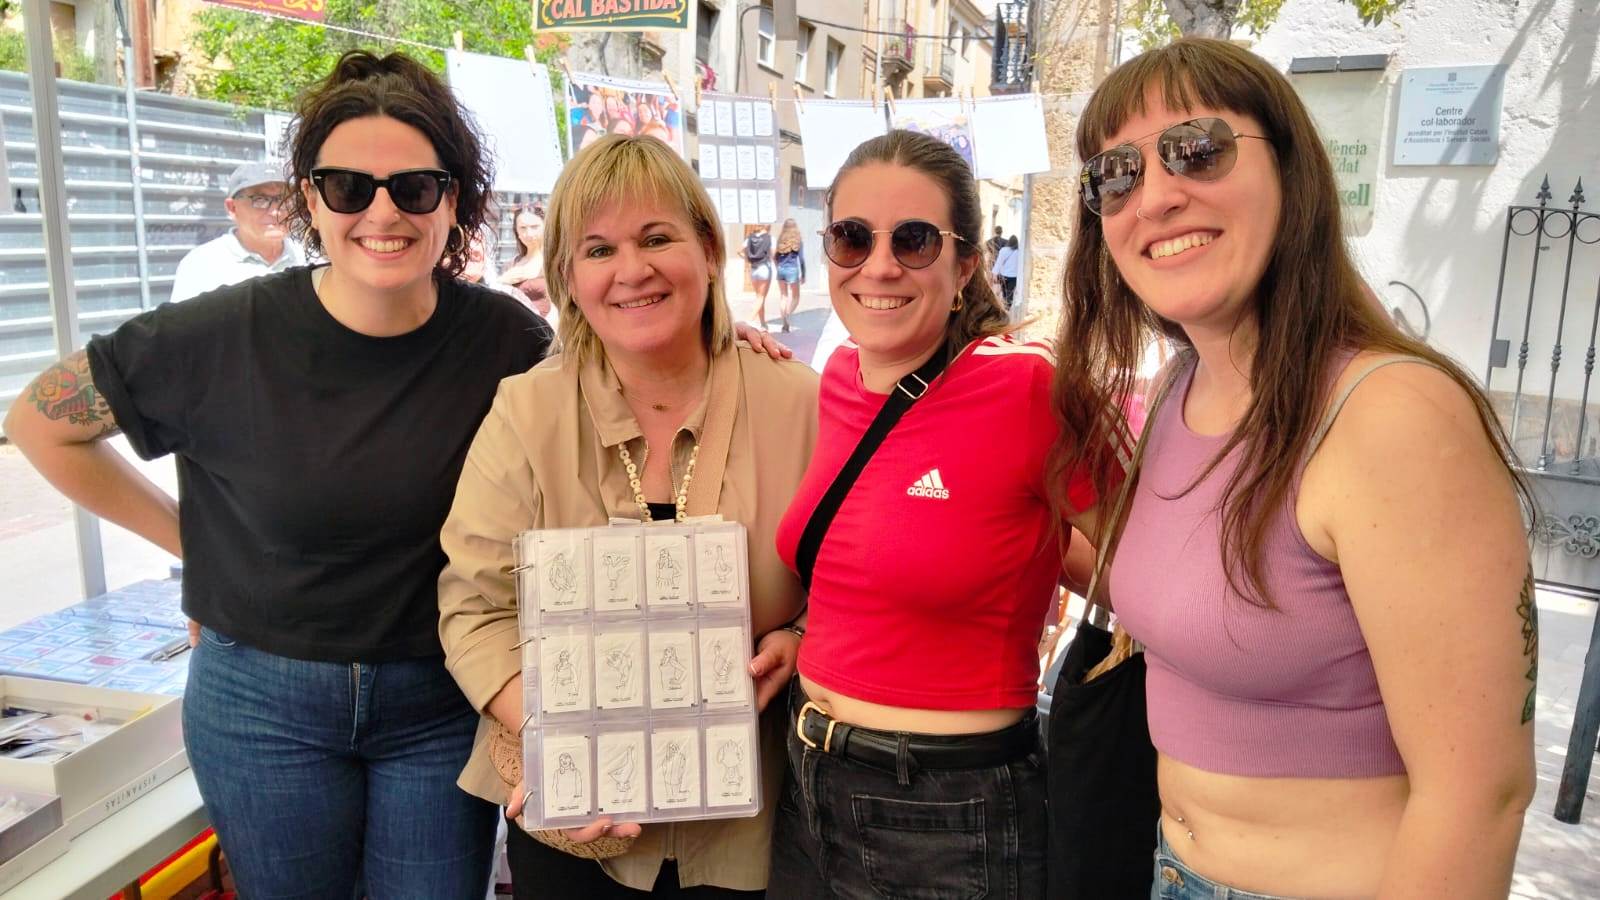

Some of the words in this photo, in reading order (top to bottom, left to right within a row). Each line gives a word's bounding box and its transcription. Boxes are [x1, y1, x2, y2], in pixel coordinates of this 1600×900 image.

[550, 0, 586, 19] CAL
[1435, 106, 1464, 116] Centre
[907, 485, 949, 500] adidas
